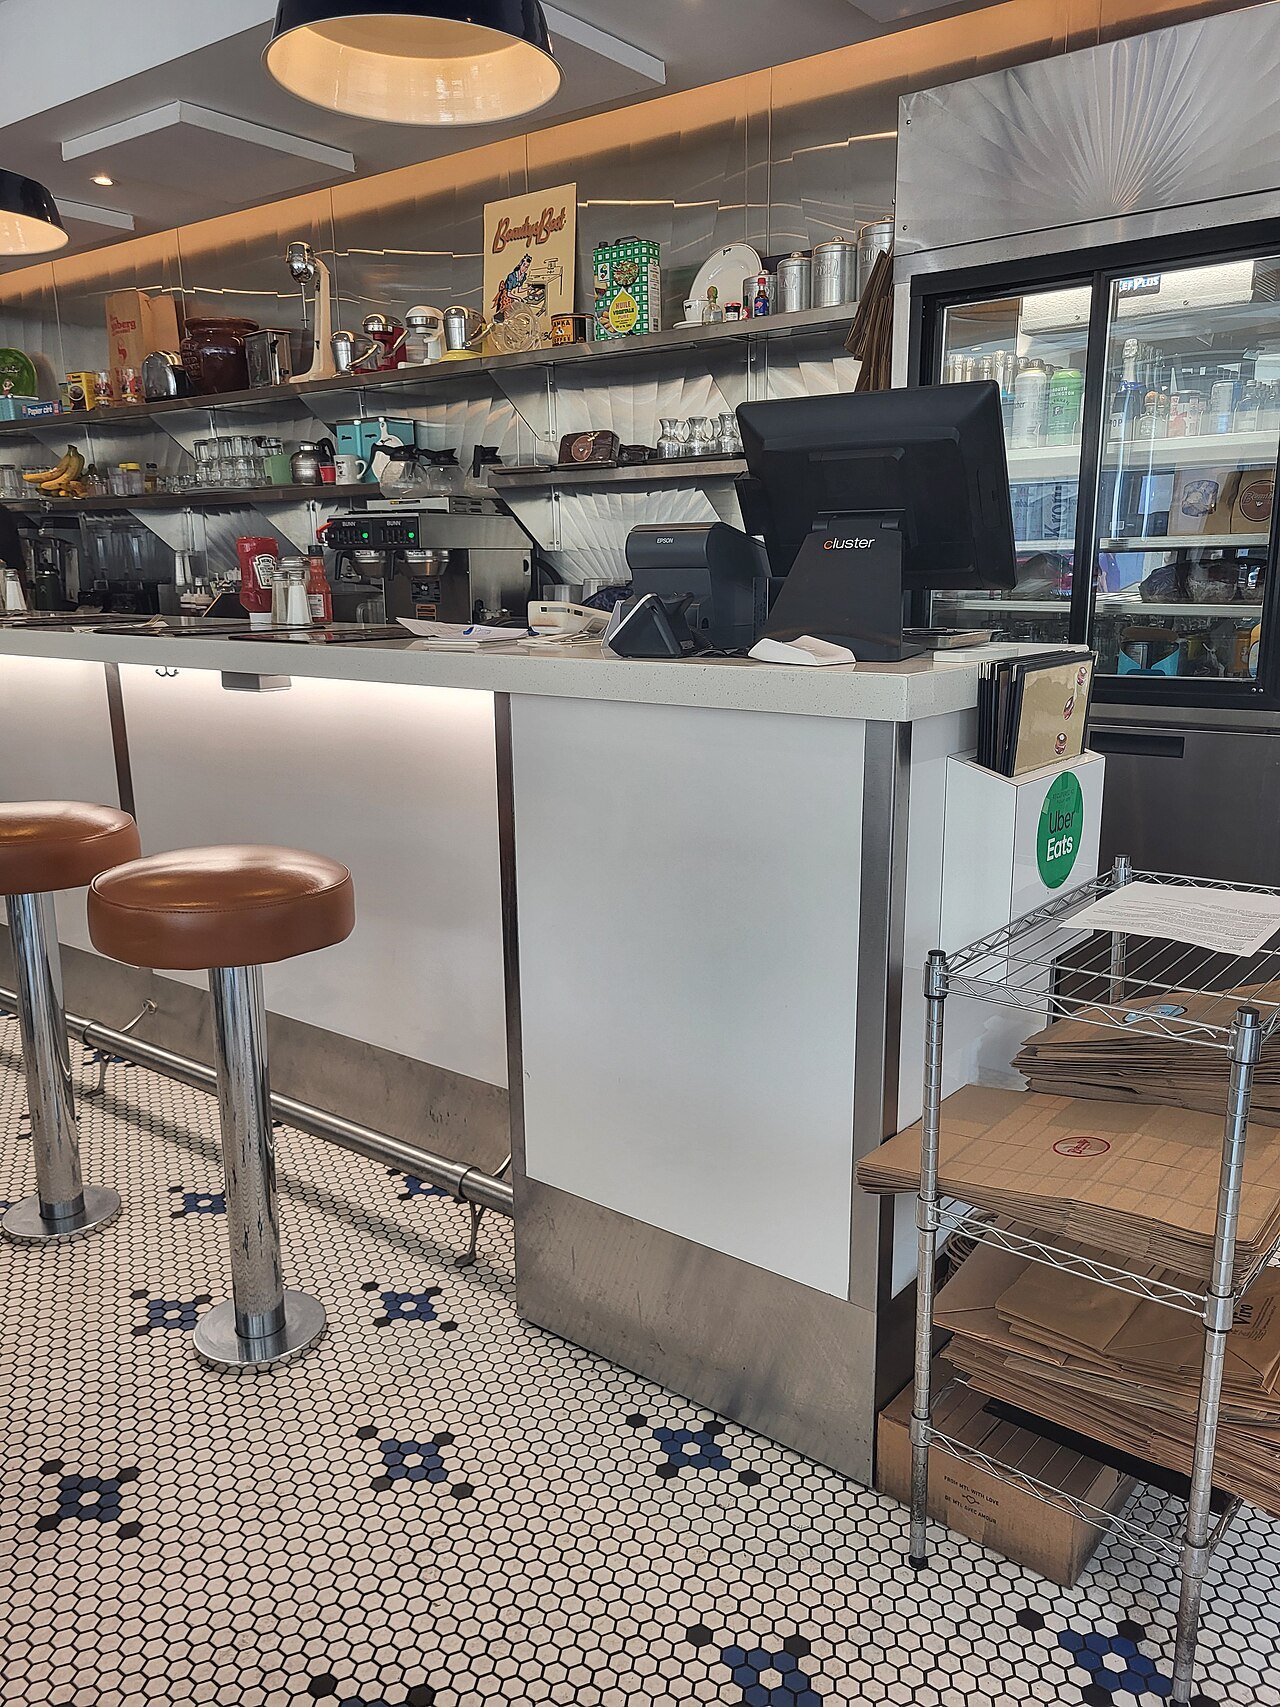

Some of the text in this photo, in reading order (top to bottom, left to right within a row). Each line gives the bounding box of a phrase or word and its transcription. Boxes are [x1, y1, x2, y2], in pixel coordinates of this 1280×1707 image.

[823, 537, 876, 550] cluster
[1049, 810, 1075, 834] Uber
[1046, 834, 1074, 862] Eats
[943, 1475, 999, 1506] FROM MTL WITH LOVE
[977, 1512, 997, 1525] AMOUR
